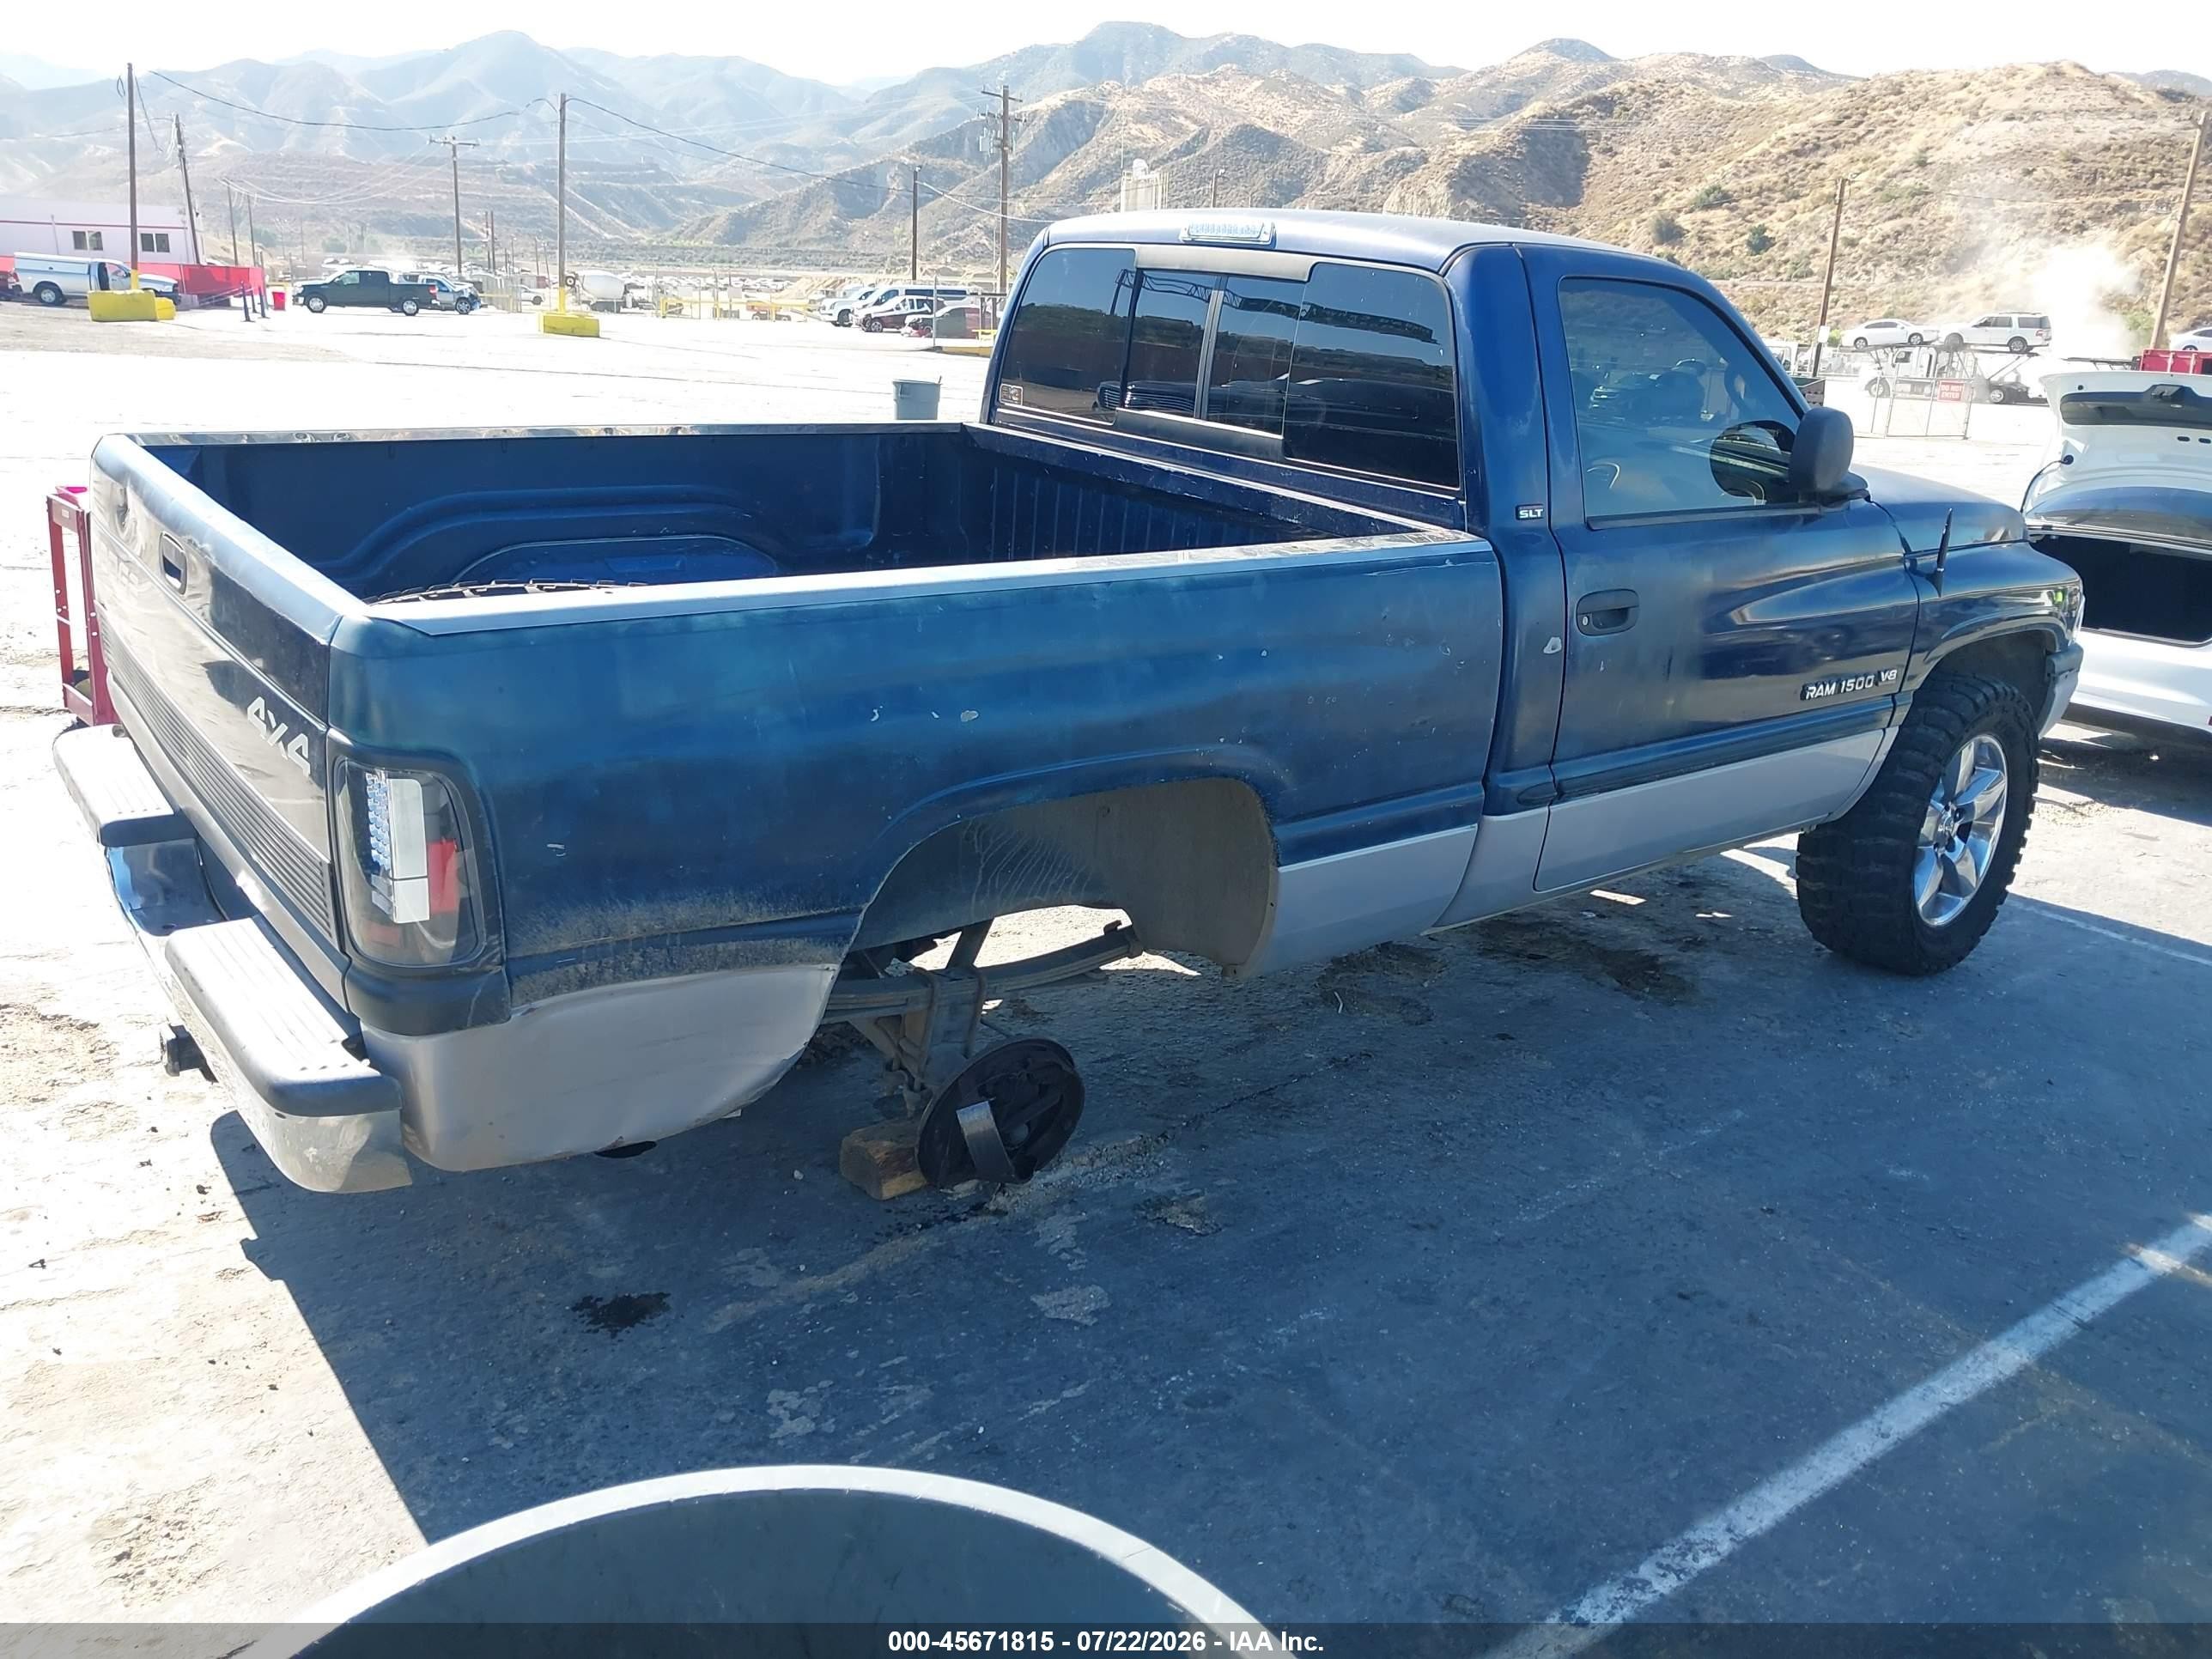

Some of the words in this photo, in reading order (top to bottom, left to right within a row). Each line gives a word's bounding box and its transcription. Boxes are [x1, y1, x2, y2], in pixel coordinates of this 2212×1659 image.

[1519, 508, 1544, 519] SLT
[1805, 682, 1837, 701] RAM
[1840, 674, 1875, 694] 1500
[1880, 669, 1898, 683] V8
[246, 696, 311, 778] 4X4
